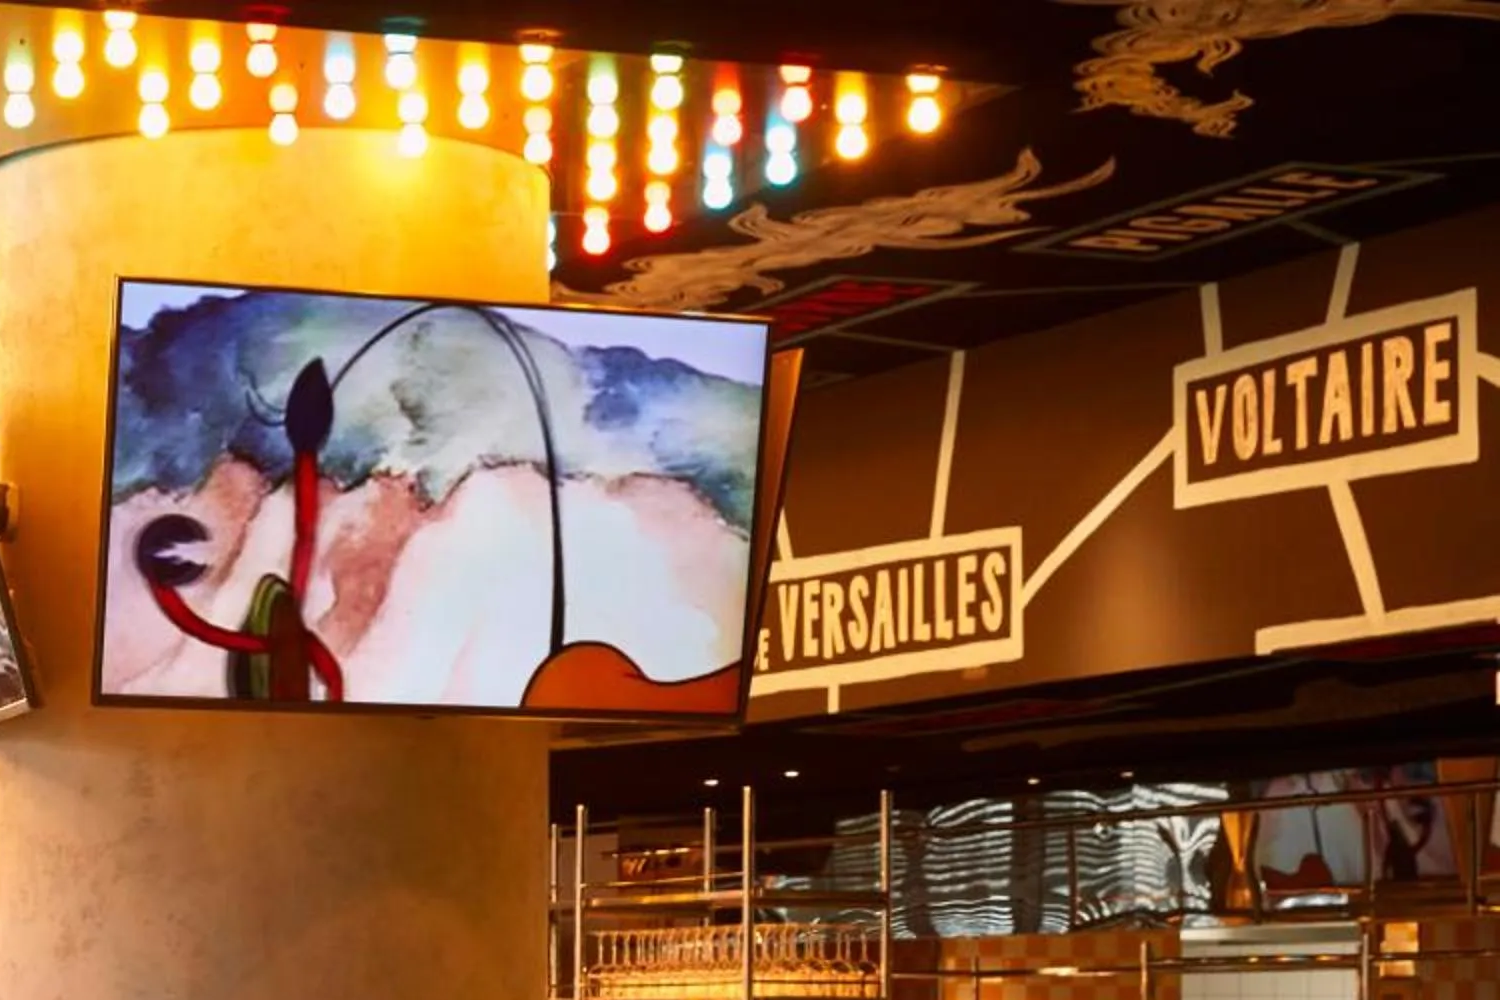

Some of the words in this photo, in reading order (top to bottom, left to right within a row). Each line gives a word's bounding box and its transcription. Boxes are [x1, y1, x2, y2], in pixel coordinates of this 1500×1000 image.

[1196, 322, 1451, 465] VOLTAIRE
[753, 628, 770, 672] E
[778, 552, 1007, 661] VERSAILLES
